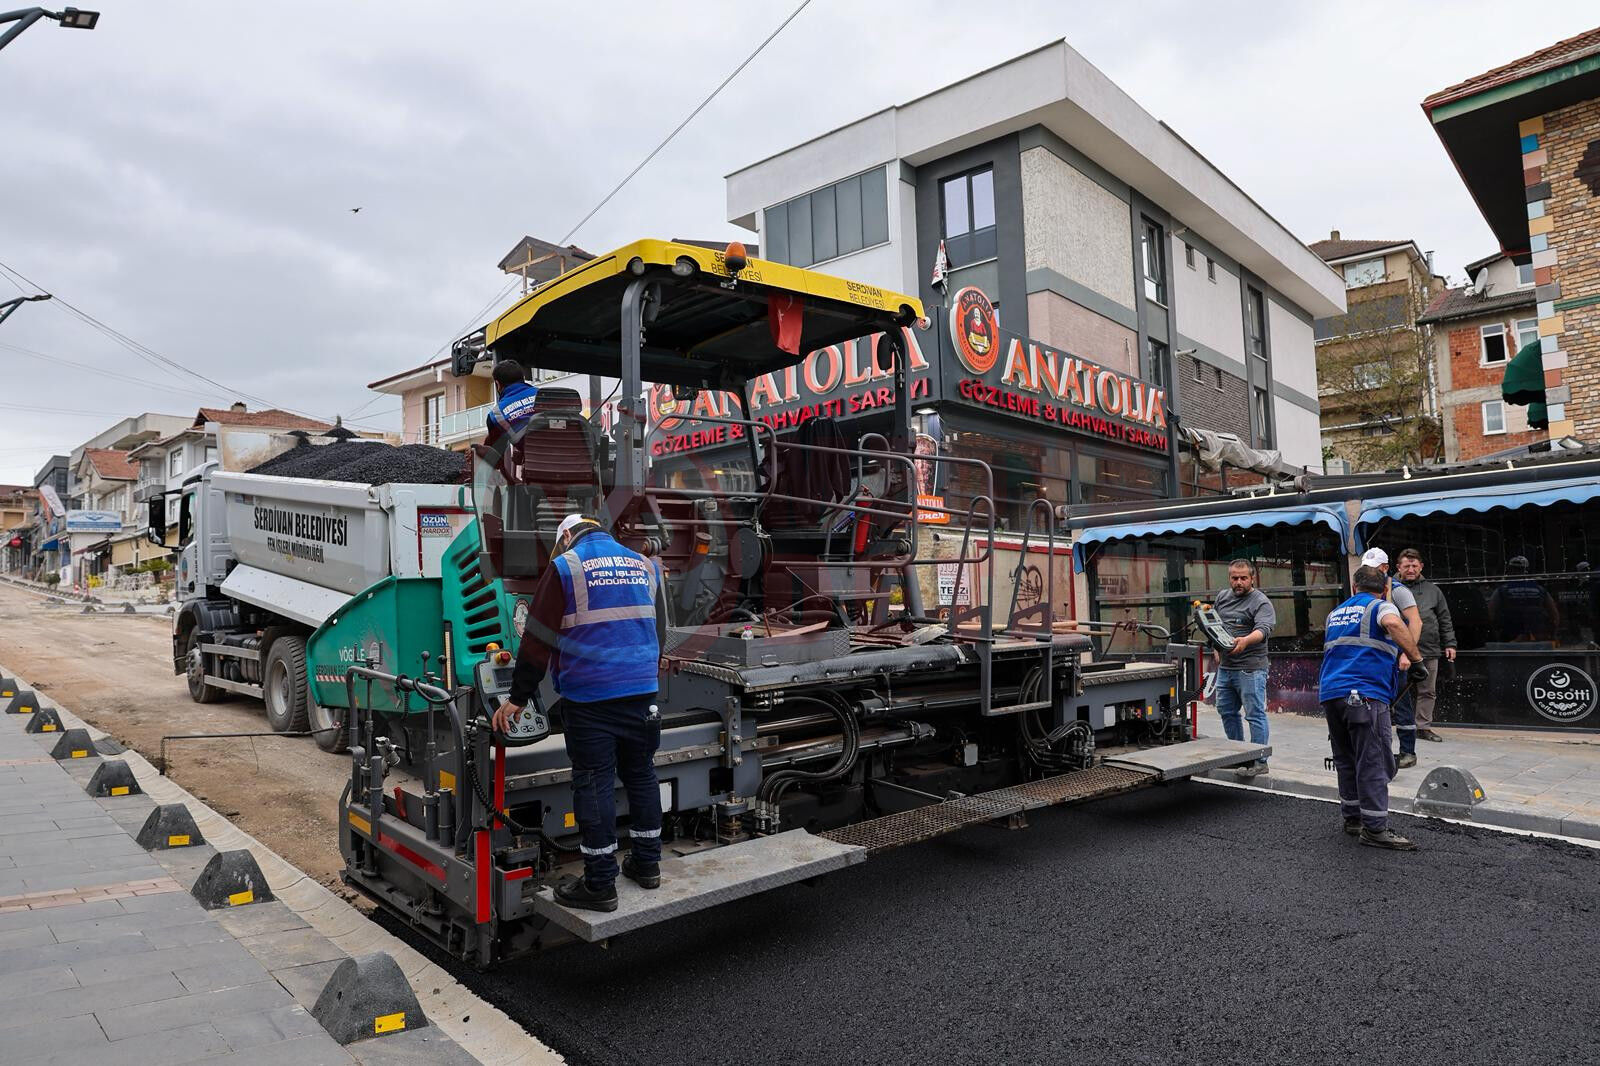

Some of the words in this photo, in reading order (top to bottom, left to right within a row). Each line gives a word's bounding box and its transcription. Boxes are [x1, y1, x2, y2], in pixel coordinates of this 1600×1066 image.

[962, 291, 993, 319] ANATOLIA
[1001, 338, 1167, 430] ANATOLIA
[959, 378, 1041, 416] GÖZLEME
[1044, 403, 1057, 421] &
[1062, 409, 1127, 440] KAHVALTI
[1127, 425, 1168, 450] SARAYI
[651, 425, 726, 456] GÖZLEME
[729, 422, 744, 439] &
[254, 505, 293, 536] SERDİVAN
[295, 512, 348, 547] BELEDİYESİ
[592, 570, 613, 578] FEN
[940, 586, 969, 595] TEZİ
[339, 646, 365, 661] VÖGLE
[1534, 687, 1590, 701] Desotti
[1538, 701, 1558, 715] coffee
[1559, 702, 1588, 717] company
